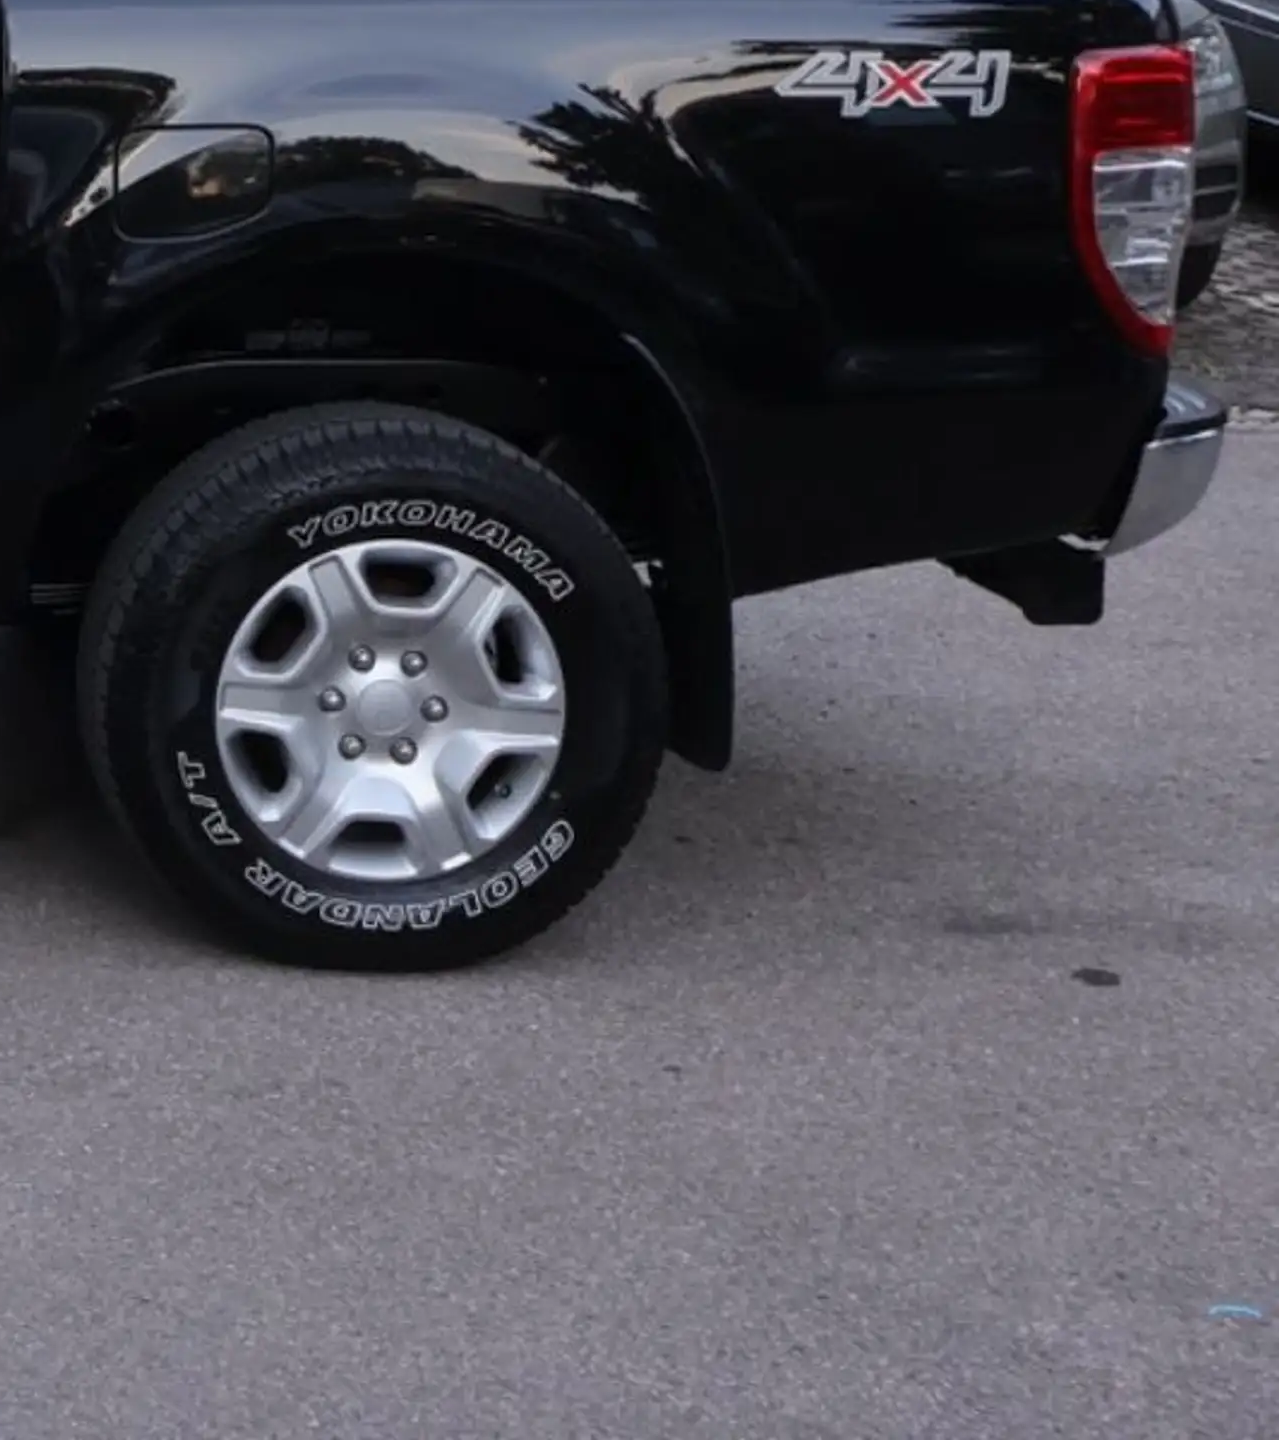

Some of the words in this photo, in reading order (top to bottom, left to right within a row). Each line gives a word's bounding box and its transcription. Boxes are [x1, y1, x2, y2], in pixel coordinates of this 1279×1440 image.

[287, 499, 576, 602] YOKOHAMA
[176, 750, 243, 848] A/T
[244, 819, 576, 932] GEOLANDAR
